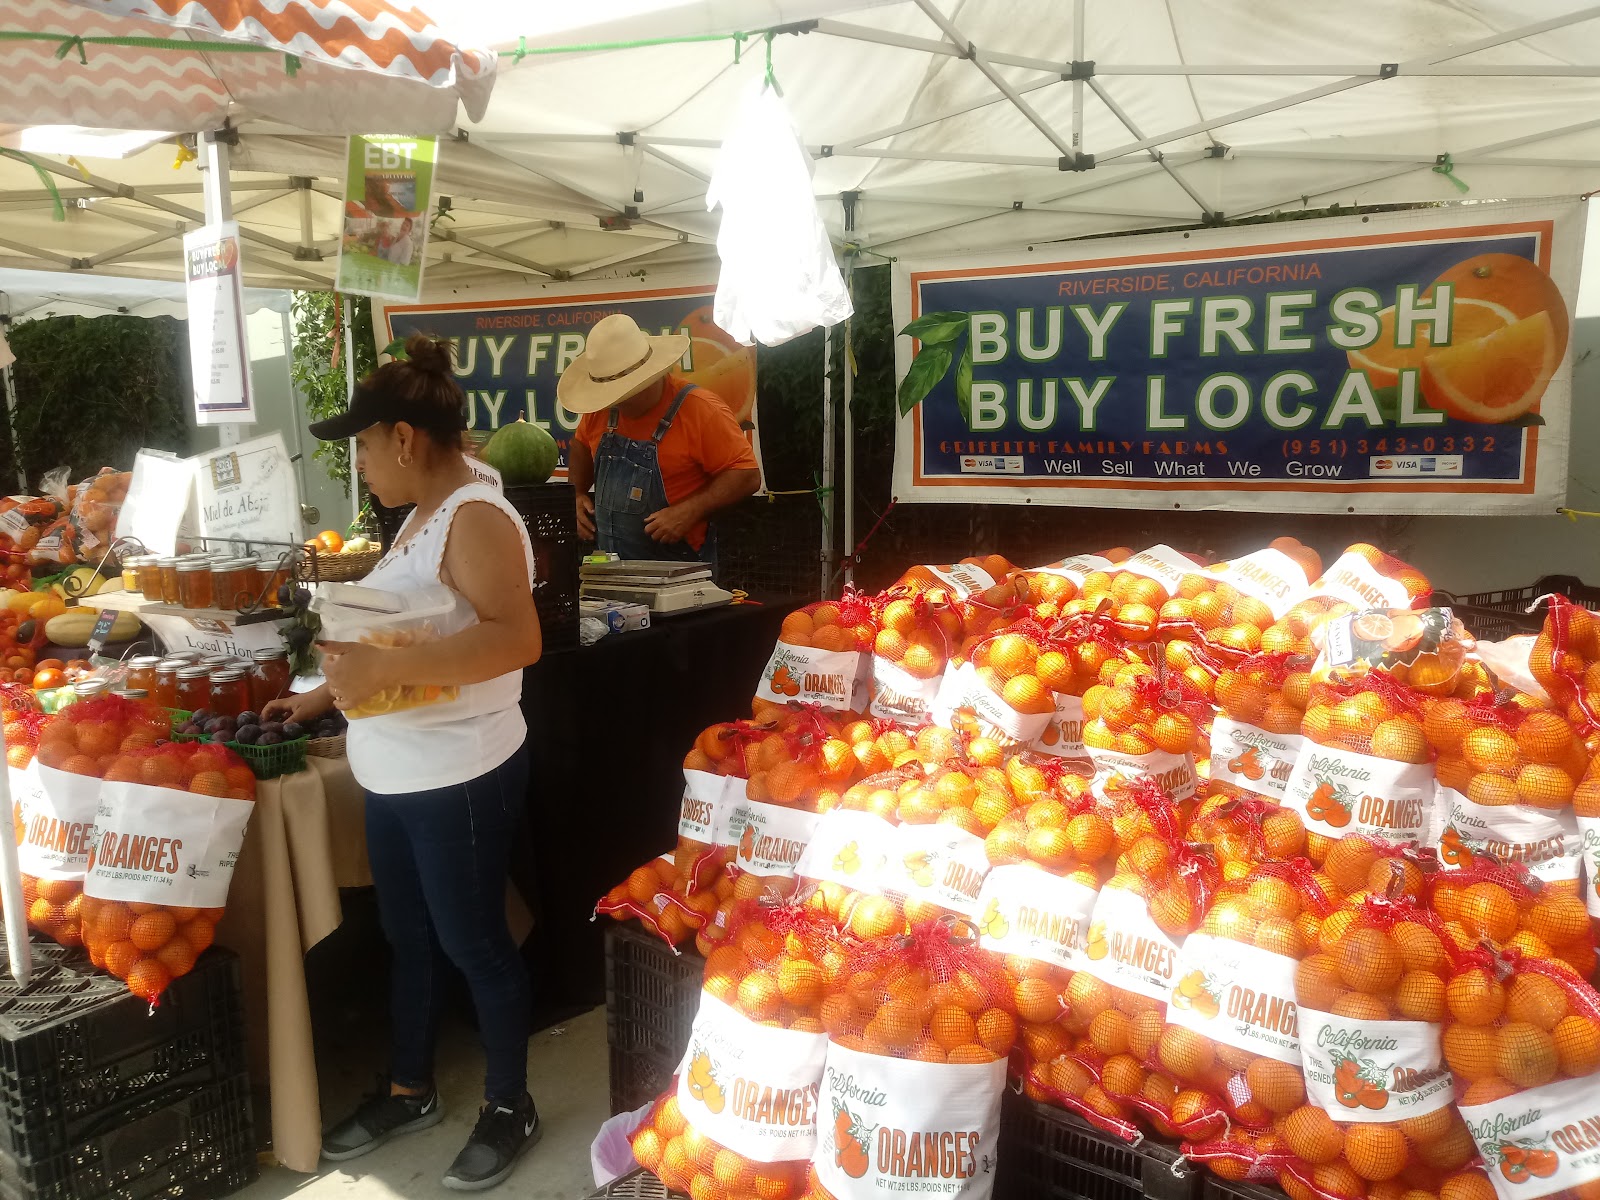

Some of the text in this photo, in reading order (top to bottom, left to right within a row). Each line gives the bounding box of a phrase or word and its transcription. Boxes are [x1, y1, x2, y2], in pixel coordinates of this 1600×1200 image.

[364, 142, 418, 169] EBT
[191, 247, 205, 262] BUY
[192, 261, 207, 276] BUY
[1058, 262, 1321, 296] RIVERSIDE, CALIFORNIA
[476, 315, 545, 329] RIVERSIDE,
[968, 282, 1455, 366] BUY FRESH
[448, 334, 517, 377] UY
[969, 367, 1447, 431] BUY LOCAL
[939, 440, 1228, 455] GRIFFITH FAMILY FARMS
[1281, 436, 1496, 457] (951) 343-0332
[1044, 459, 1343, 477] Well Sell What We Grow
[1396, 461, 1418, 469] VISA
[203, 502, 221, 523] Miel
[222, 500, 234, 517] de
[1233, 559, 1292, 599] ORANGES
[185, 635, 253, 659] Local Hon
[1229, 729, 1288, 751] California
[1307, 753, 1371, 782] California
[1358, 794, 1424, 829] ORANGES
[28, 813, 94, 855] ORANGE
[99, 830, 183, 875] ORANGES
[227, 851, 239, 859] TRE
[754, 834, 808, 865] ORANGE
[1485, 832, 1566, 864] ORANGES
[219, 860, 235, 868] RIPE
[142, 874, 152, 882] NET
[153, 876, 166, 884] 11.34
[166, 877, 173, 886] kg
[1278, 1038, 1290, 1048] NET
[1316, 1023, 1400, 1052] California
[827, 1066, 888, 1107] California
[732, 1076, 818, 1126] ORANGES
[1398, 1098, 1410, 1106] NET
[787, 1129, 799, 1138] NET
[877, 1126, 980, 1179] ORANGES
[875, 1176, 887, 1188] NET
[943, 1184, 956, 1194] NET
